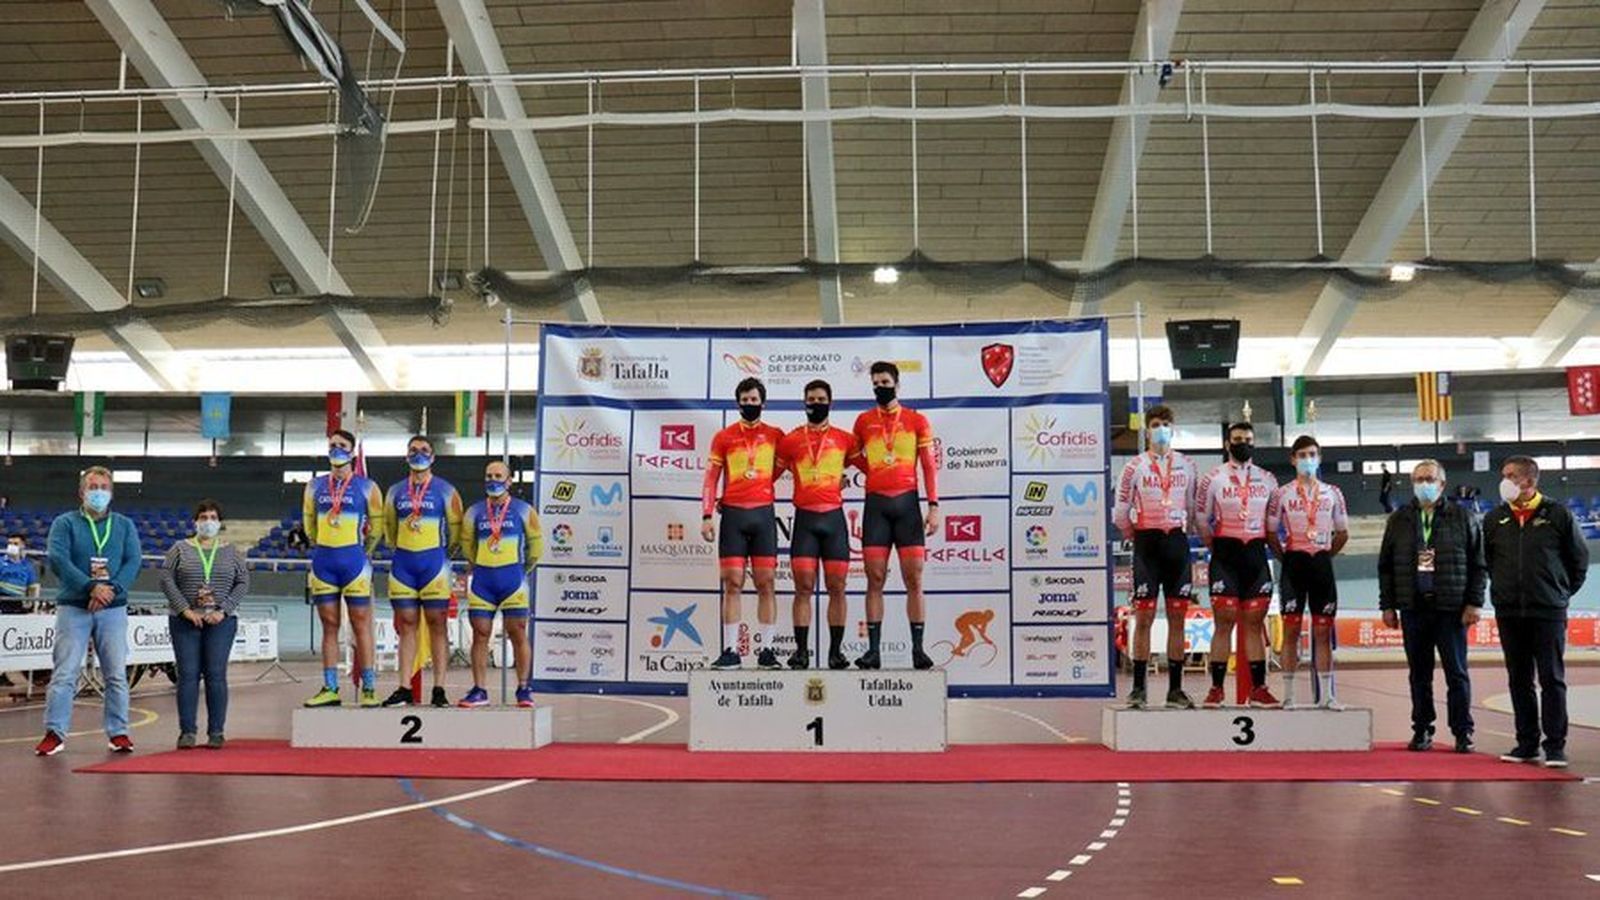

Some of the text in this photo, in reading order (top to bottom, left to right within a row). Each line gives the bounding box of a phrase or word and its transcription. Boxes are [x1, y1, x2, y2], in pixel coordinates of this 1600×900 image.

[768, 353, 842, 363] CAMPEONATO
[610, 362, 669, 379] Tafalla
[768, 362, 826, 373] DE ESPAÑA
[565, 432, 623, 448] Cofidis
[1036, 431, 1097, 447] Cofidis
[946, 446, 998, 457] Gobierno
[636, 453, 706, 471] TAFALL
[946, 458, 1007, 470] de Navarra
[1142, 475, 1186, 488] MARID
[1222, 486, 1267, 499] MARID
[639, 544, 714, 557] MASQUATRO
[924, 547, 1006, 563] TAFALLA
[2, 627, 55, 651] CaixaB
[709, 678, 784, 693] Ayuntamiento
[859, 678, 913, 691] Tafallako
[717, 694, 774, 707] de Tafalla
[868, 694, 903, 707] Udala
[400, 715, 423, 744] 2
[806, 716, 824, 746] 1
[1231, 716, 1256, 746] 3
